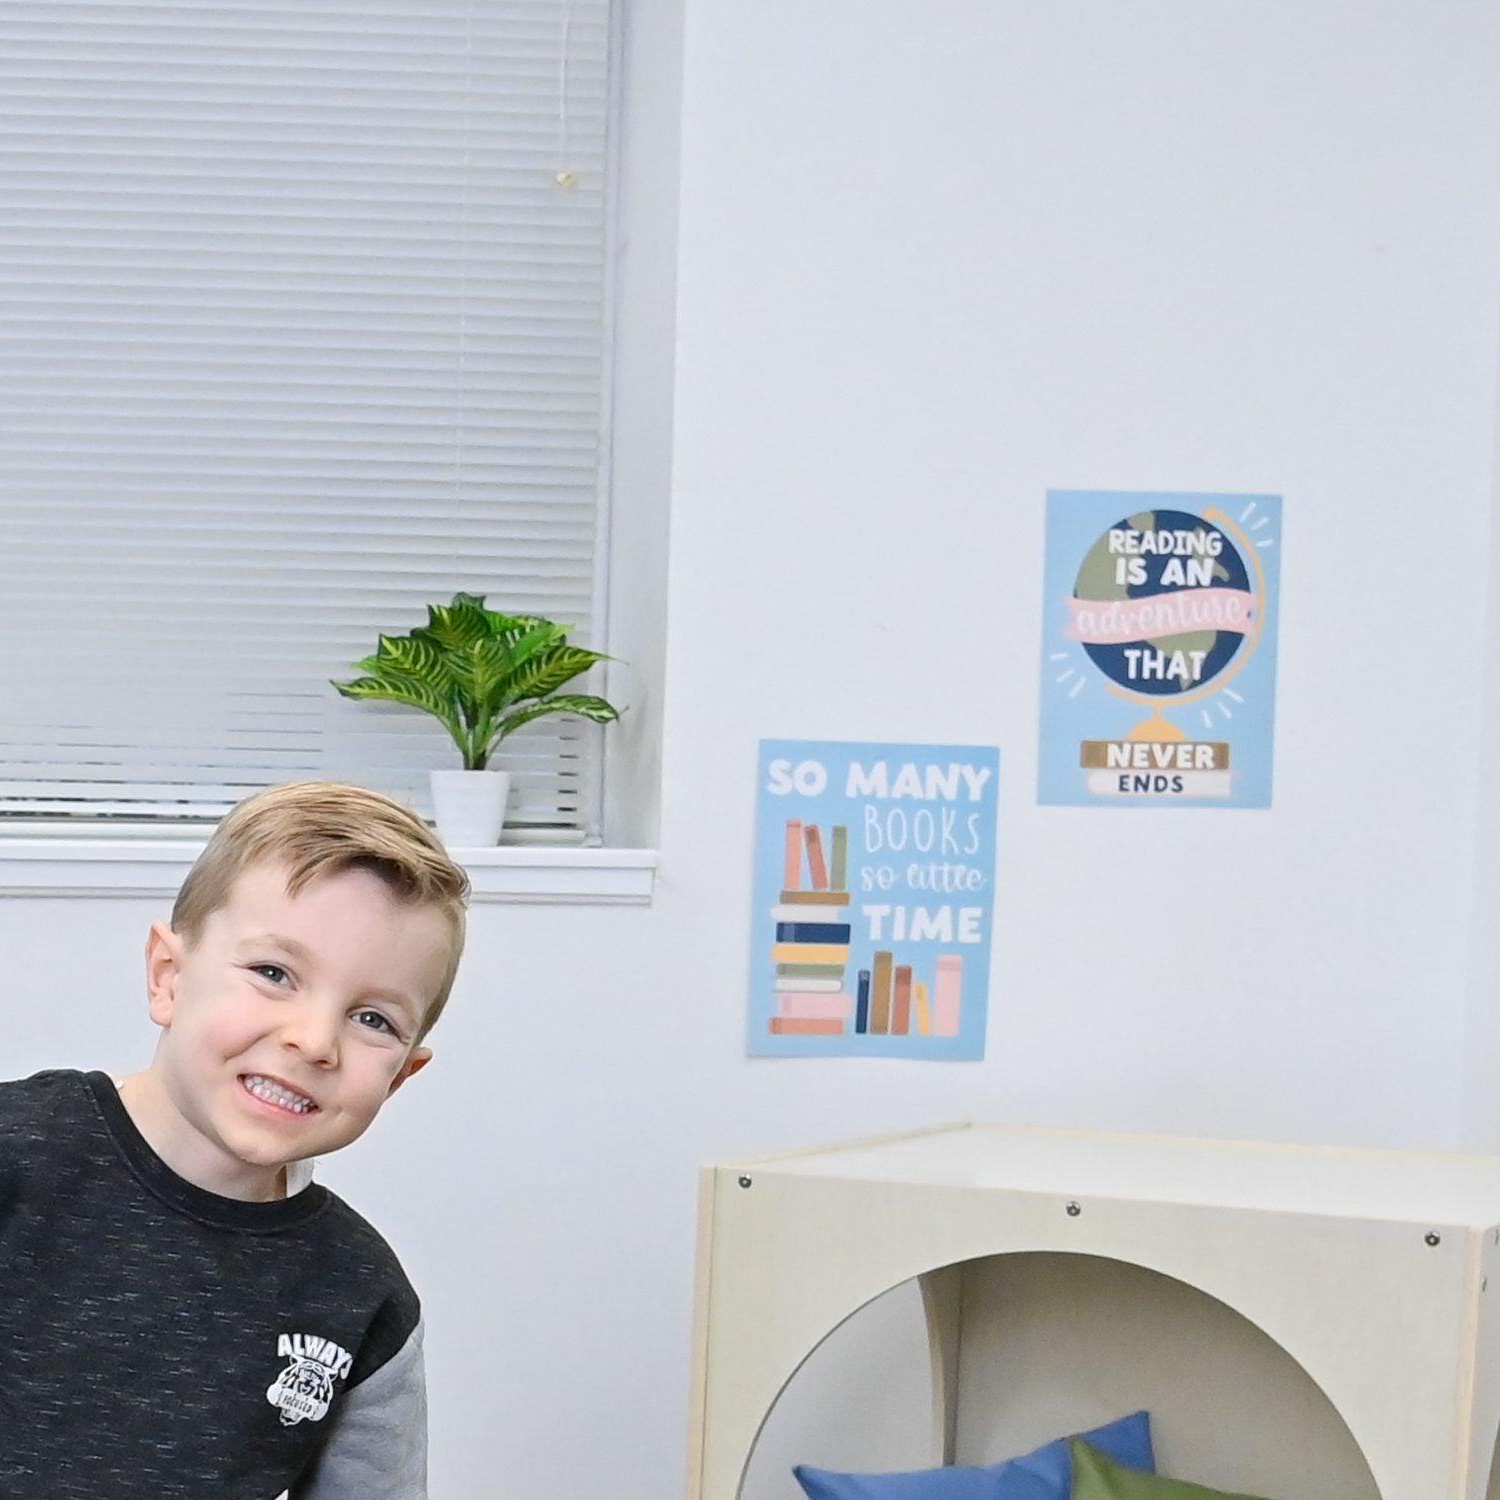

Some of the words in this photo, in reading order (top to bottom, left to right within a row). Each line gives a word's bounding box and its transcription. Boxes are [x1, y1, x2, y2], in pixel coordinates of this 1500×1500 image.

[1108, 529, 1222, 556] READING
[1115, 557, 1147, 585] IS
[1160, 558, 1214, 587] AN
[1076, 593, 1241, 635] adventure
[1124, 649, 1206, 680] THAT
[1106, 743, 1215, 769] NEVER
[767, 758, 828, 796] SO
[845, 761, 992, 801] MANY
[1118, 774, 1183, 792] ENDS
[864, 804, 980, 855] BOOKS
[861, 865, 896, 892] so
[906, 862, 985, 893] little
[862, 904, 982, 944] TIME
